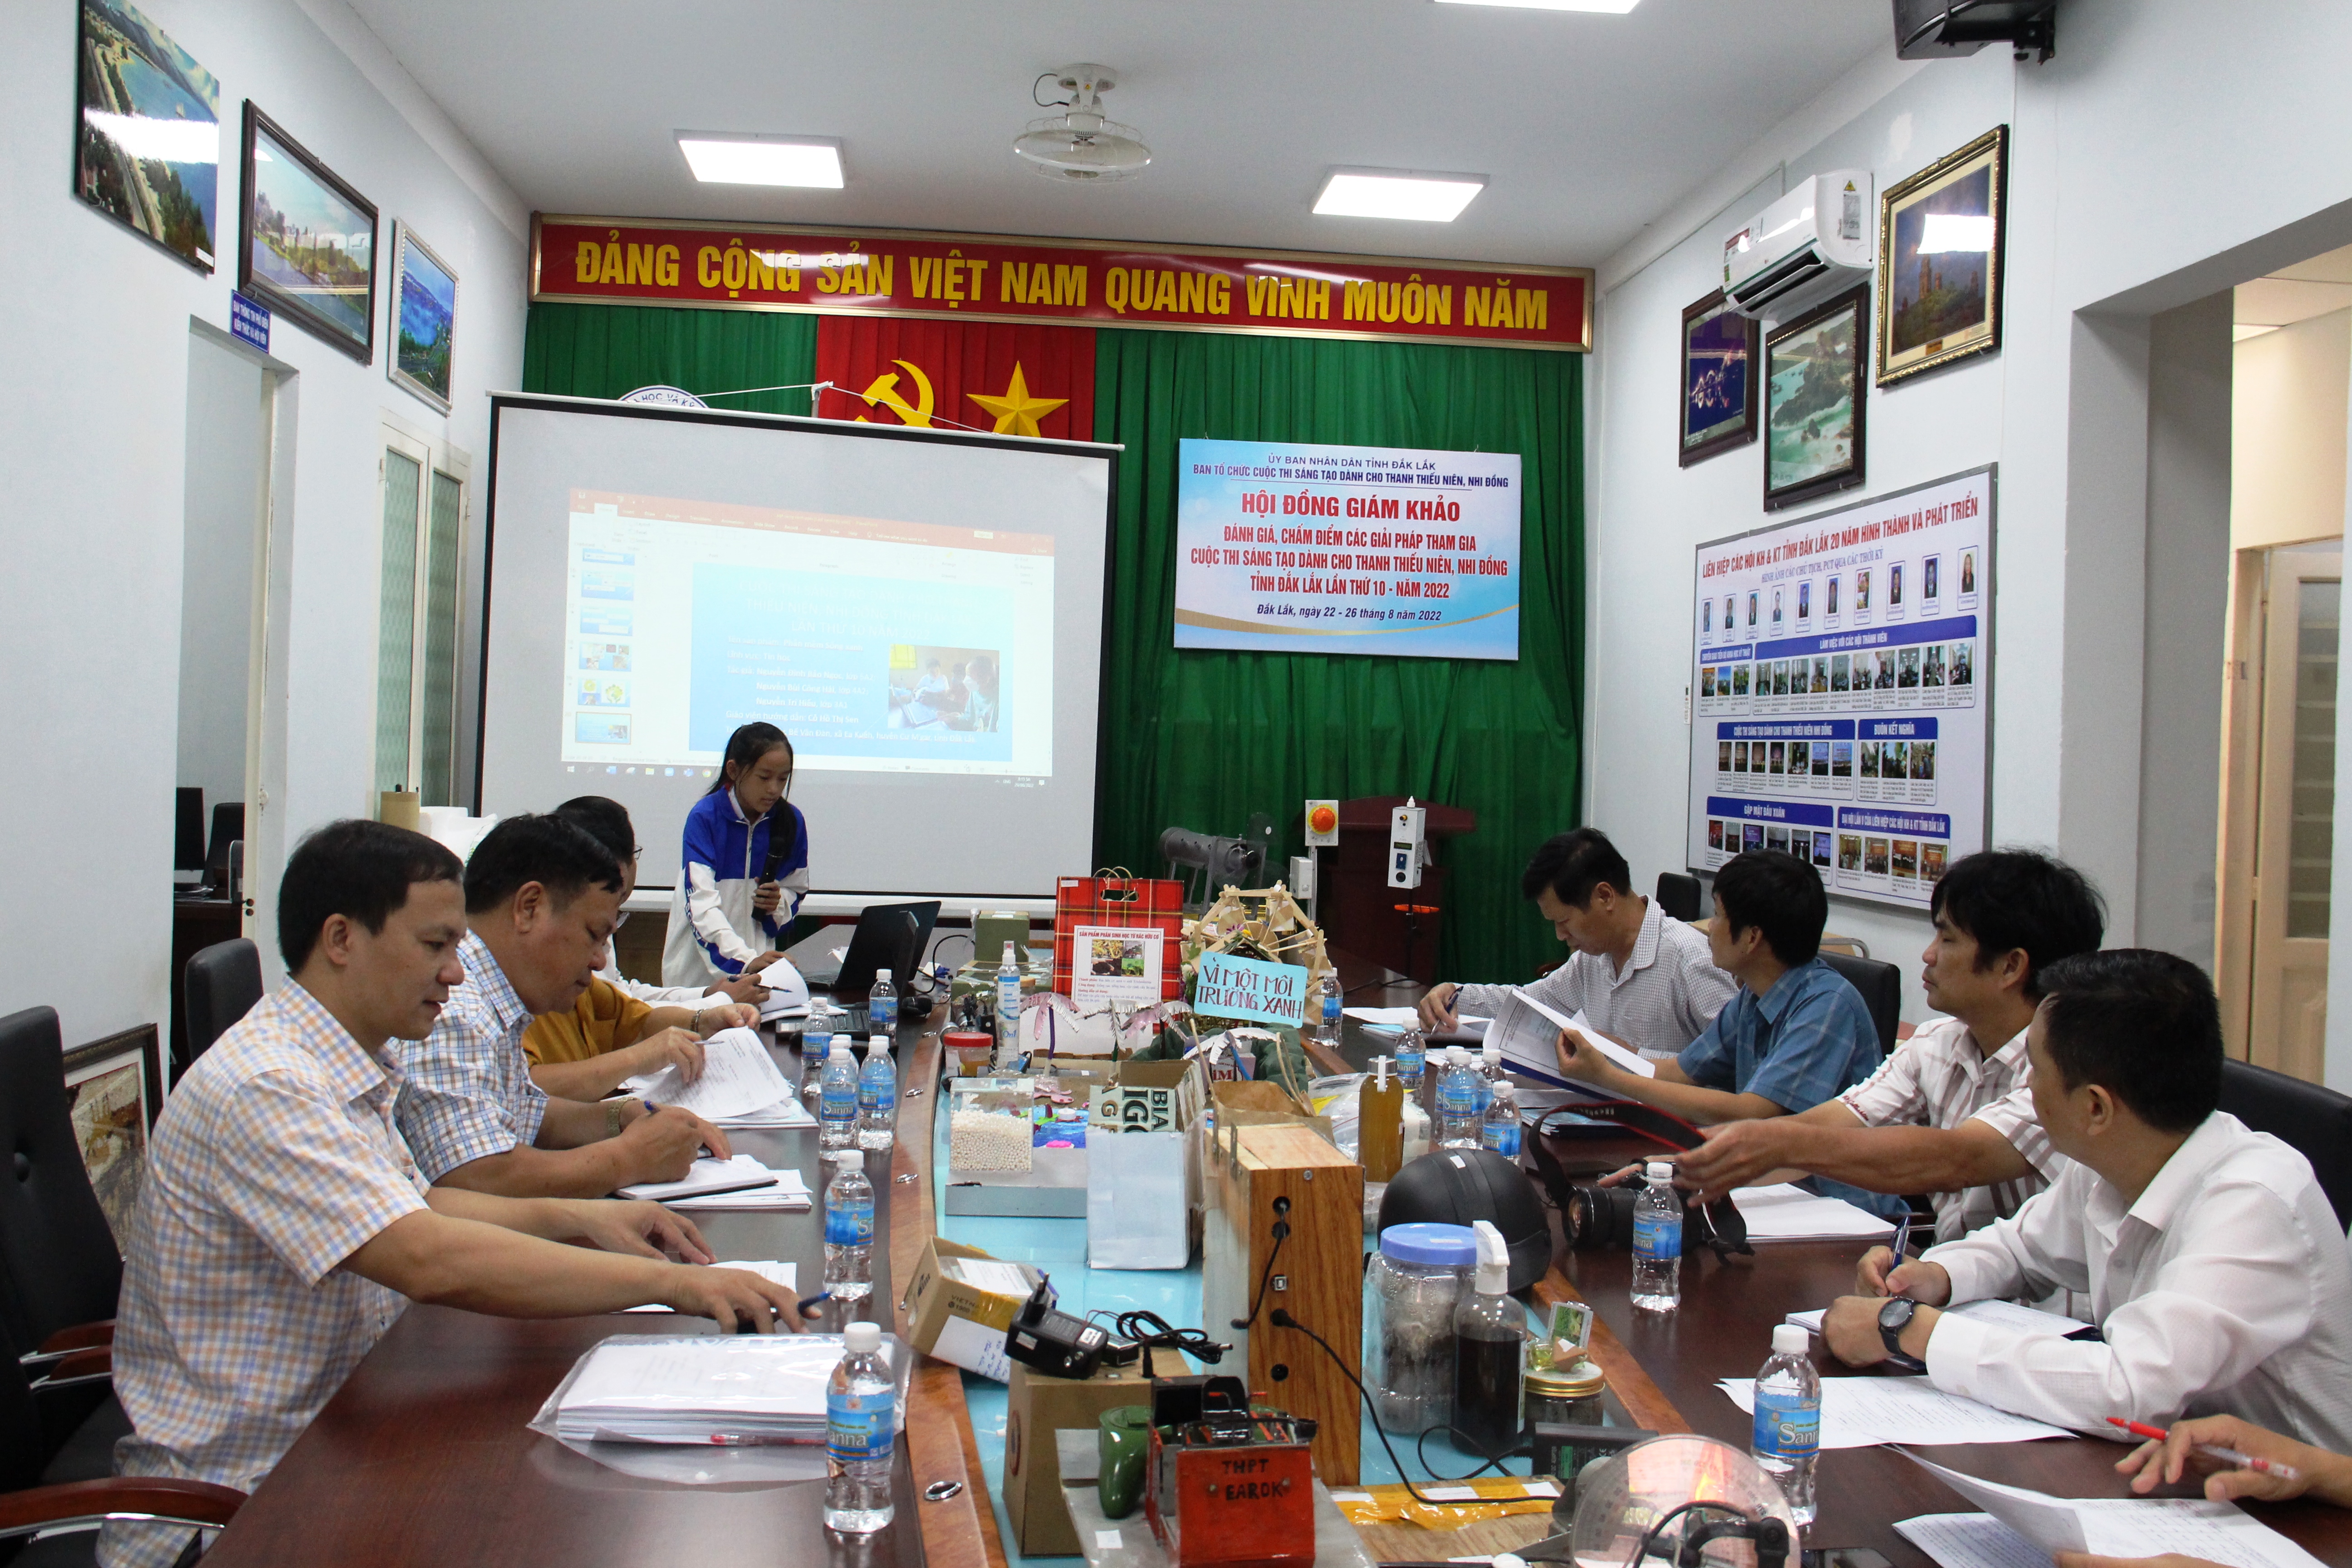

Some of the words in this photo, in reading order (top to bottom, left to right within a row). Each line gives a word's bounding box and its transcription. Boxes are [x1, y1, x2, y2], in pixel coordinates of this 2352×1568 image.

[576, 230, 680, 287] ĐẢNG
[697, 238, 802, 298] CỘNG
[817, 241, 893, 296] SẢN
[910, 249, 988, 309] VIỆT
[1001, 262, 1088, 307] NAM
[1106, 268, 1230, 315] QUANG
[1245, 275, 1330, 320] VINH
[1344, 273, 1452, 326] MUÔN
[1465, 280, 1548, 330] NĂM
[642, 393, 663, 402] HỌC
[1193, 464, 1211, 474] BAN
[1214, 461, 1224, 475] TỔ
[1227, 465, 1250, 476] CHỨC
[1253, 466, 1276, 479] CUỘC
[1279, 468, 1292, 478] THI
[1294, 467, 1318, 479] SÁNG
[1321, 470, 1337, 481] TẠO
[1339, 469, 1363, 481] DÀNH
[1366, 472, 1382, 482] CHO
[1385, 473, 1413, 483] THANH
[1416, 472, 1440, 485] THIẾU
[1442, 473, 1465, 487] NIÊN,
[1468, 476, 1482, 486] NHI
[1485, 474, 1508, 487] ĐỒNG
[1268, 452, 1281, 463] ỦY
[1285, 456, 1305, 464] BAN
[1309, 456, 1337, 466] NHÂN
[1341, 457, 1362, 467] DÂN
[1365, 457, 1388, 468] TỈNH
[1392, 458, 1412, 469] ĐẮK
[1416, 459, 1435, 470] LẮK
[1242, 490, 1275, 518] HỘI
[1282, 489, 1338, 516] ĐỒNG
[1346, 494, 1398, 519] GIÁM
[1406, 495, 1460, 521] KHẢO
[1224, 523, 1253, 542] ĐÁNH
[1257, 525, 1277, 545] GIÁ,
[1281, 523, 1312, 544] CHẤM
[1315, 524, 1343, 546] ĐIỂM
[1346, 528, 1367, 547] CÁC
[1370, 527, 1391, 548] GIẢI
[1395, 530, 1423, 549] PHÁP
[1426, 534, 1455, 550] THAM
[1459, 535, 1476, 551] GIA
[1703, 560, 1715, 578] LIÊN
[1716, 556, 1730, 577] HIỆP
[1731, 553, 1743, 572] CÁC
[1744, 550, 1755, 571] HỘI
[1756, 550, 1764, 566] KH
[1766, 549, 1771, 564] &
[1773, 546, 1781, 563] KT
[1783, 539, 1798, 560] TỈNH
[1798, 534, 1813, 557] ĐẮK
[1815, 530, 1828, 554] LẮK
[1830, 532, 1839, 549] 20
[1841, 526, 1859, 547] NĂM
[1861, 521, 1880, 543] HÌNH
[1882, 514, 1909, 538] THÀNH
[1912, 508, 1923, 531] VÀ
[1925, 502, 1948, 528] PHÁT
[1950, 491, 1978, 521] TRIỂN
[1191, 545, 1219, 568] CUỘC
[1223, 549, 1239, 565] THI
[1243, 547, 1272, 567] SÁNG
[1275, 551, 1295, 572] TẠO
[1298, 549, 1328, 569] DÀNH
[1331, 554, 1352, 569] CHO
[1355, 554, 1390, 571] THANH
[1393, 552, 1422, 573] THIẾU
[1426, 555, 1454, 575] NIÊN,
[1458, 559, 1475, 574] NHI
[1479, 554, 1507, 576] ĐỒNG
[1250, 571, 1274, 591] TỈNH
[1278, 572, 1299, 592] ĐẮK
[1303, 572, 1322, 593] LẮK
[1326, 574, 1346, 594] LẦN
[1349, 576, 1371, 595] THỨ
[1373, 580, 1385, 596] 10
[1396, 578, 1420, 597] NĂM
[1424, 582, 1449, 598] 2022
[1257, 603, 1275, 614] Đắk
[1277, 603, 1296, 617] Lắk,
[1299, 606, 1321, 618] ngày
[1323, 607, 1335, 617] 22
[1345, 607, 1357, 617] 26
[1360, 608, 1385, 620] tháng
[1388, 609, 1394, 619] 8
[1396, 610, 1415, 619] năm
[1418, 610, 1441, 620] 2022
[852, 625, 865, 636] 10
[902, 628, 931, 641] 2022
[1203, 957, 1220, 984] VÌ
[1222, 968, 1259, 991] MỘT
[1264, 975, 1293, 997] MÔI
[1198, 985, 1258, 1010] TRƯỜNG
[1262, 995, 1303, 1019] XANH
[824, 1102, 854, 1114] Sanna
[1152, 1089, 1169, 1132] BIA
[1445, 1097, 1471, 1111] Sanna
[828, 1431, 867, 1446] anna
[1221, 1458, 1269, 1475] THPT
